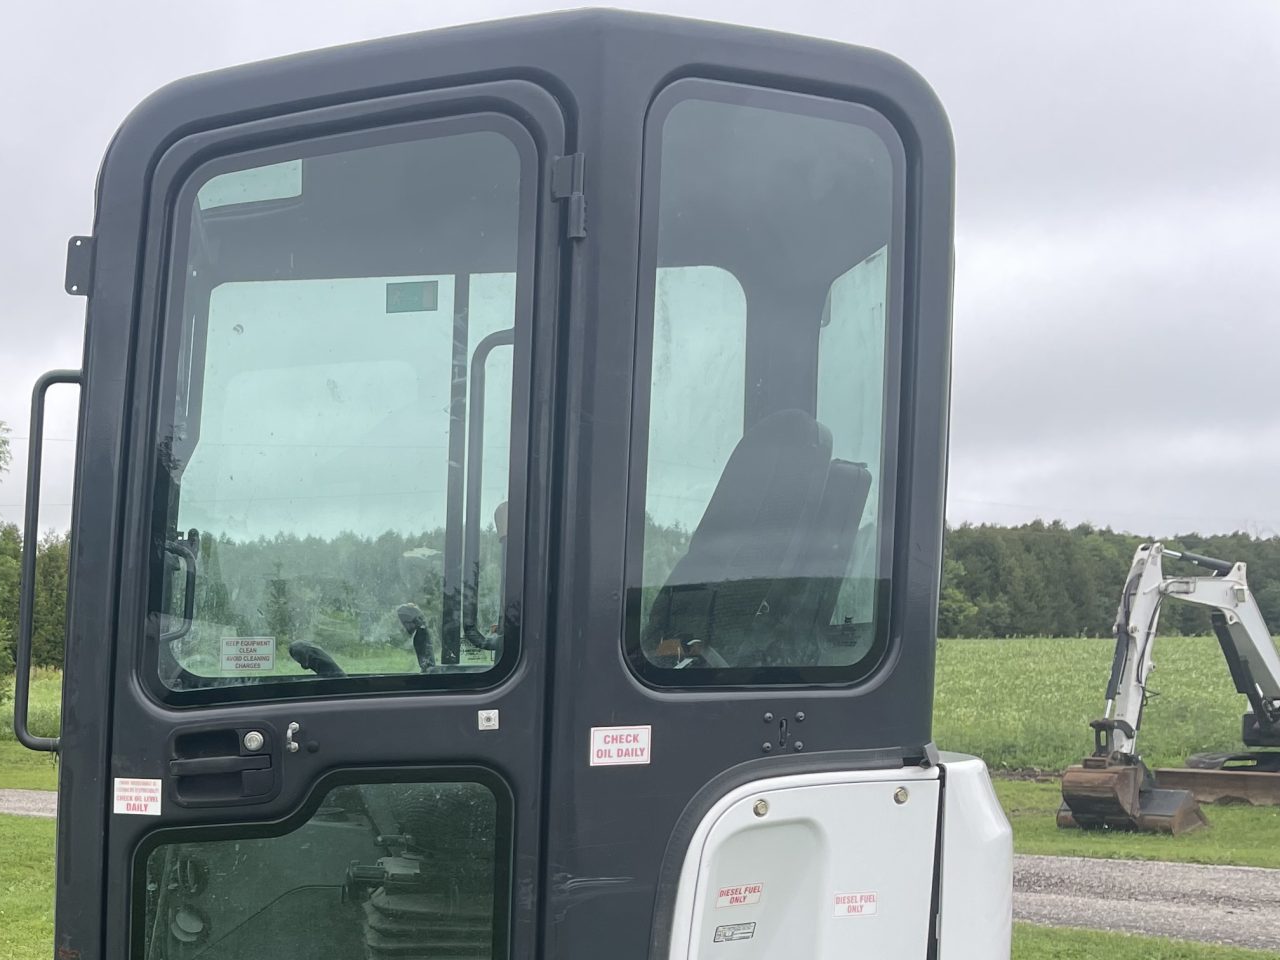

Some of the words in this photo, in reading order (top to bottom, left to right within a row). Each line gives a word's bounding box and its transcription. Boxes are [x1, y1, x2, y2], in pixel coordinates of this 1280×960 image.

[604, 734, 639, 744] CHECK
[596, 749, 613, 758] OIL
[617, 747, 645, 757] DAILY
[126, 803, 148, 811] DAILY
[720, 888, 742, 897] DIESEL
[744, 886, 760, 894] FUEL
[729, 896, 746, 904] ONLY
[835, 896, 858, 904] DIESEL
[860, 895, 875, 903] FUEL
[847, 904, 863, 913] ONLY
